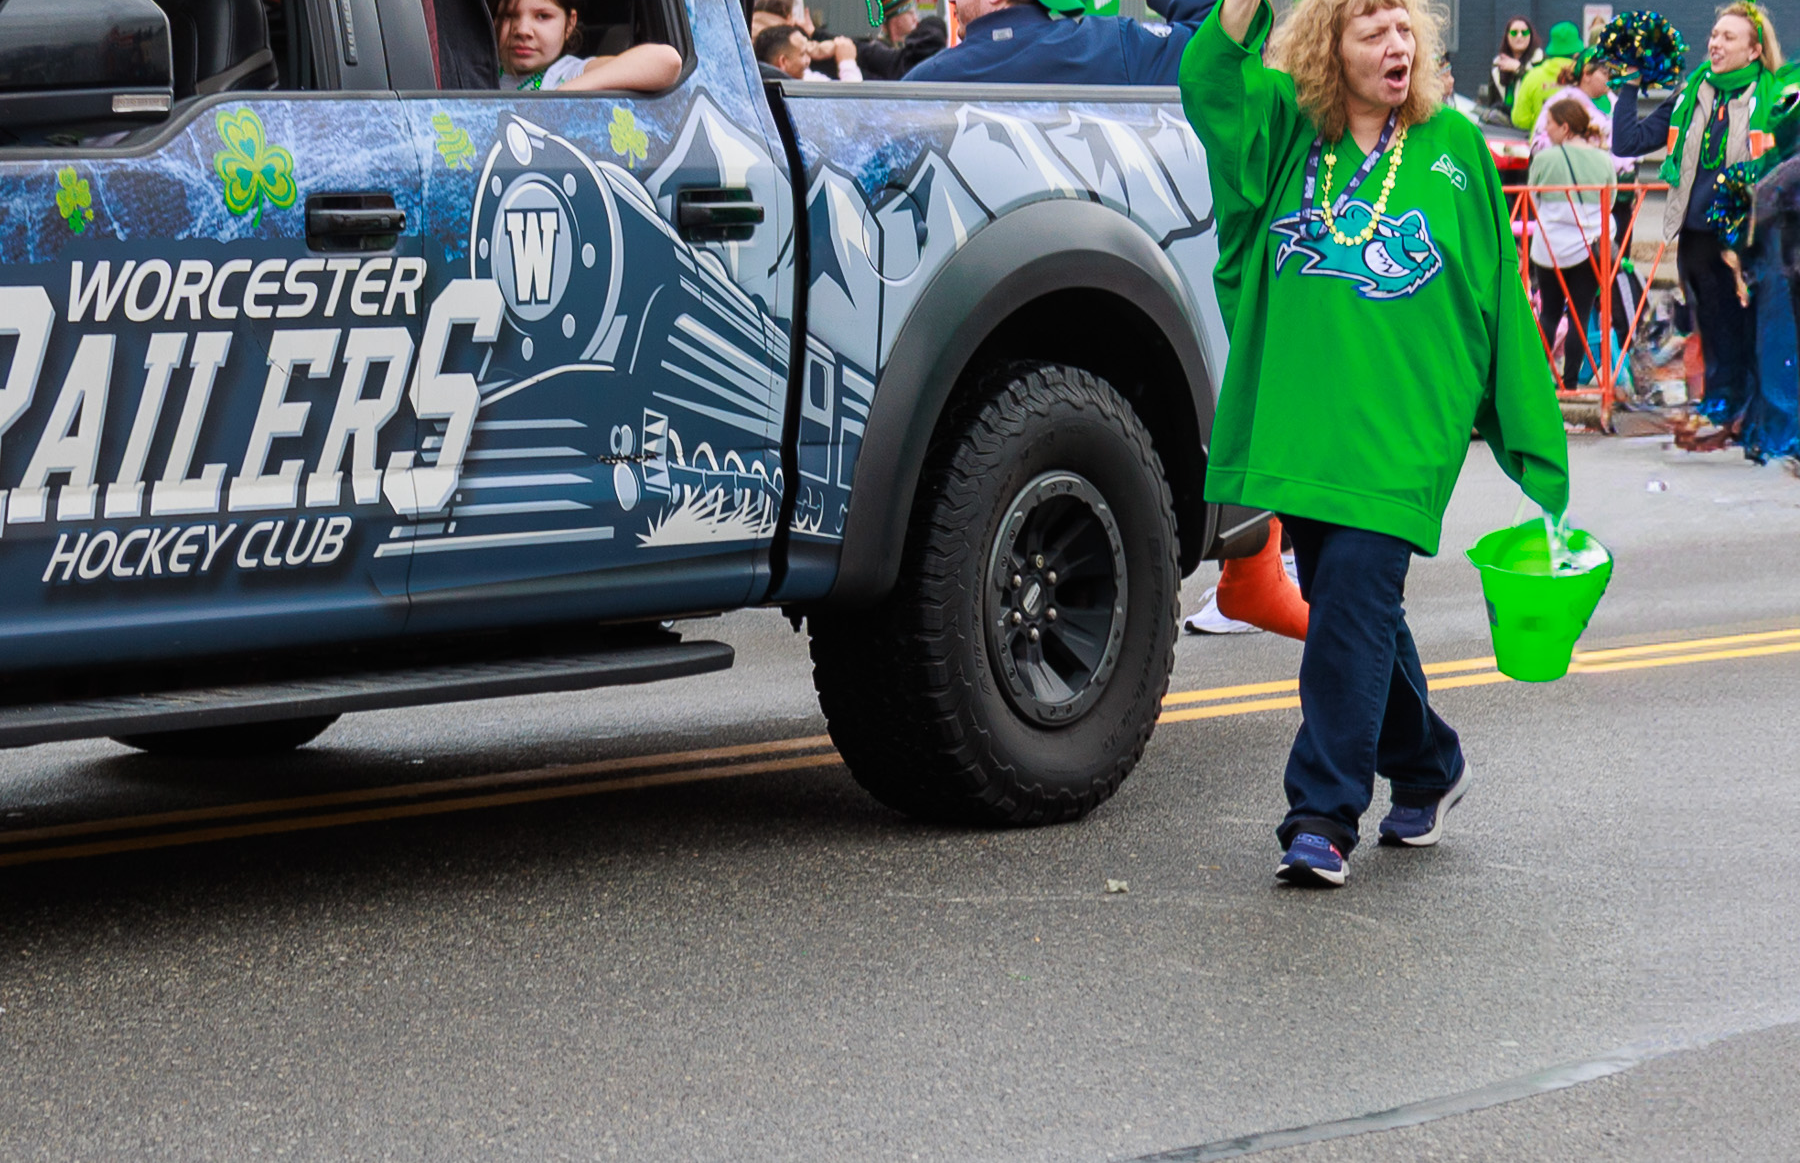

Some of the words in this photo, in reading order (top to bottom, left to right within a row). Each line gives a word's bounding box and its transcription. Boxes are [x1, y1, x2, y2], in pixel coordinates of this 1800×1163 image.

[67, 256, 427, 323] WORCESTER
[505, 208, 560, 305] W
[42, 522, 238, 584] HOCKEY
[237, 516, 353, 568] CLUB
